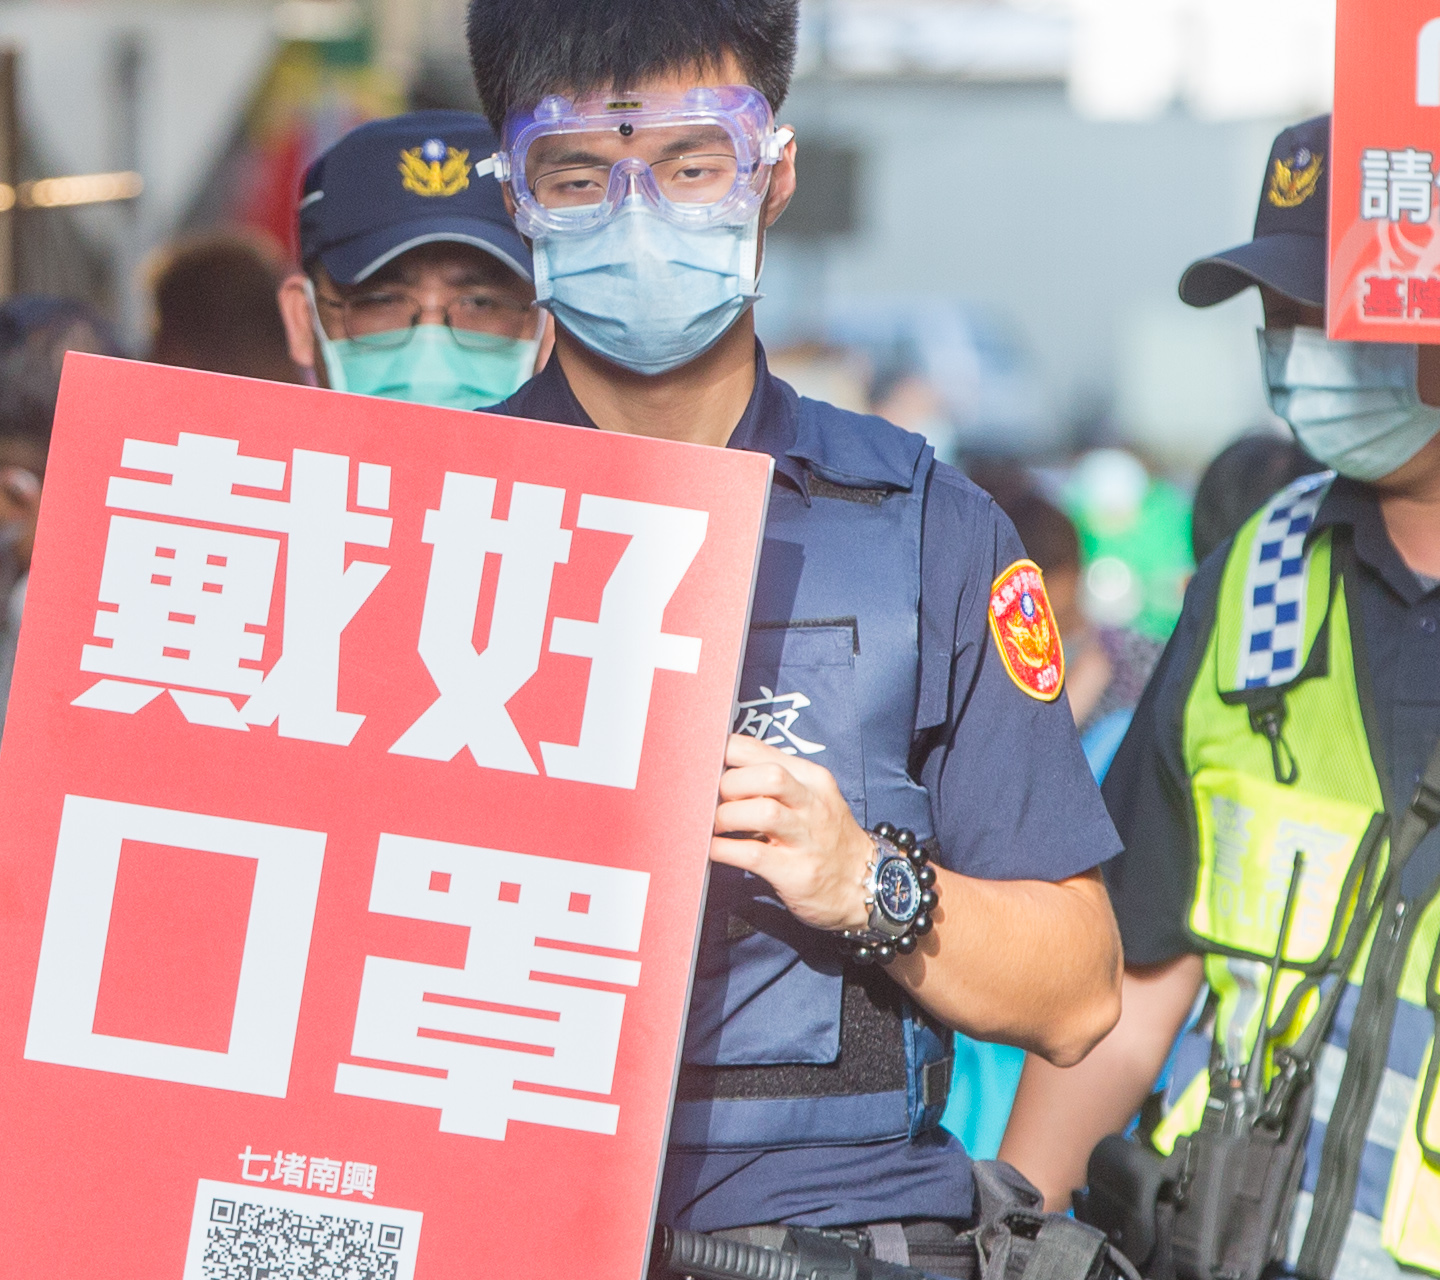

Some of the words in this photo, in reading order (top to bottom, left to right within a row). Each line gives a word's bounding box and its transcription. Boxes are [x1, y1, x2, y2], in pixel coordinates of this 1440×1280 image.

[69, 431, 711, 789] 戴好
[23, 792, 652, 1141] 口罩
[238, 1145, 378, 1199] 七堵南興
